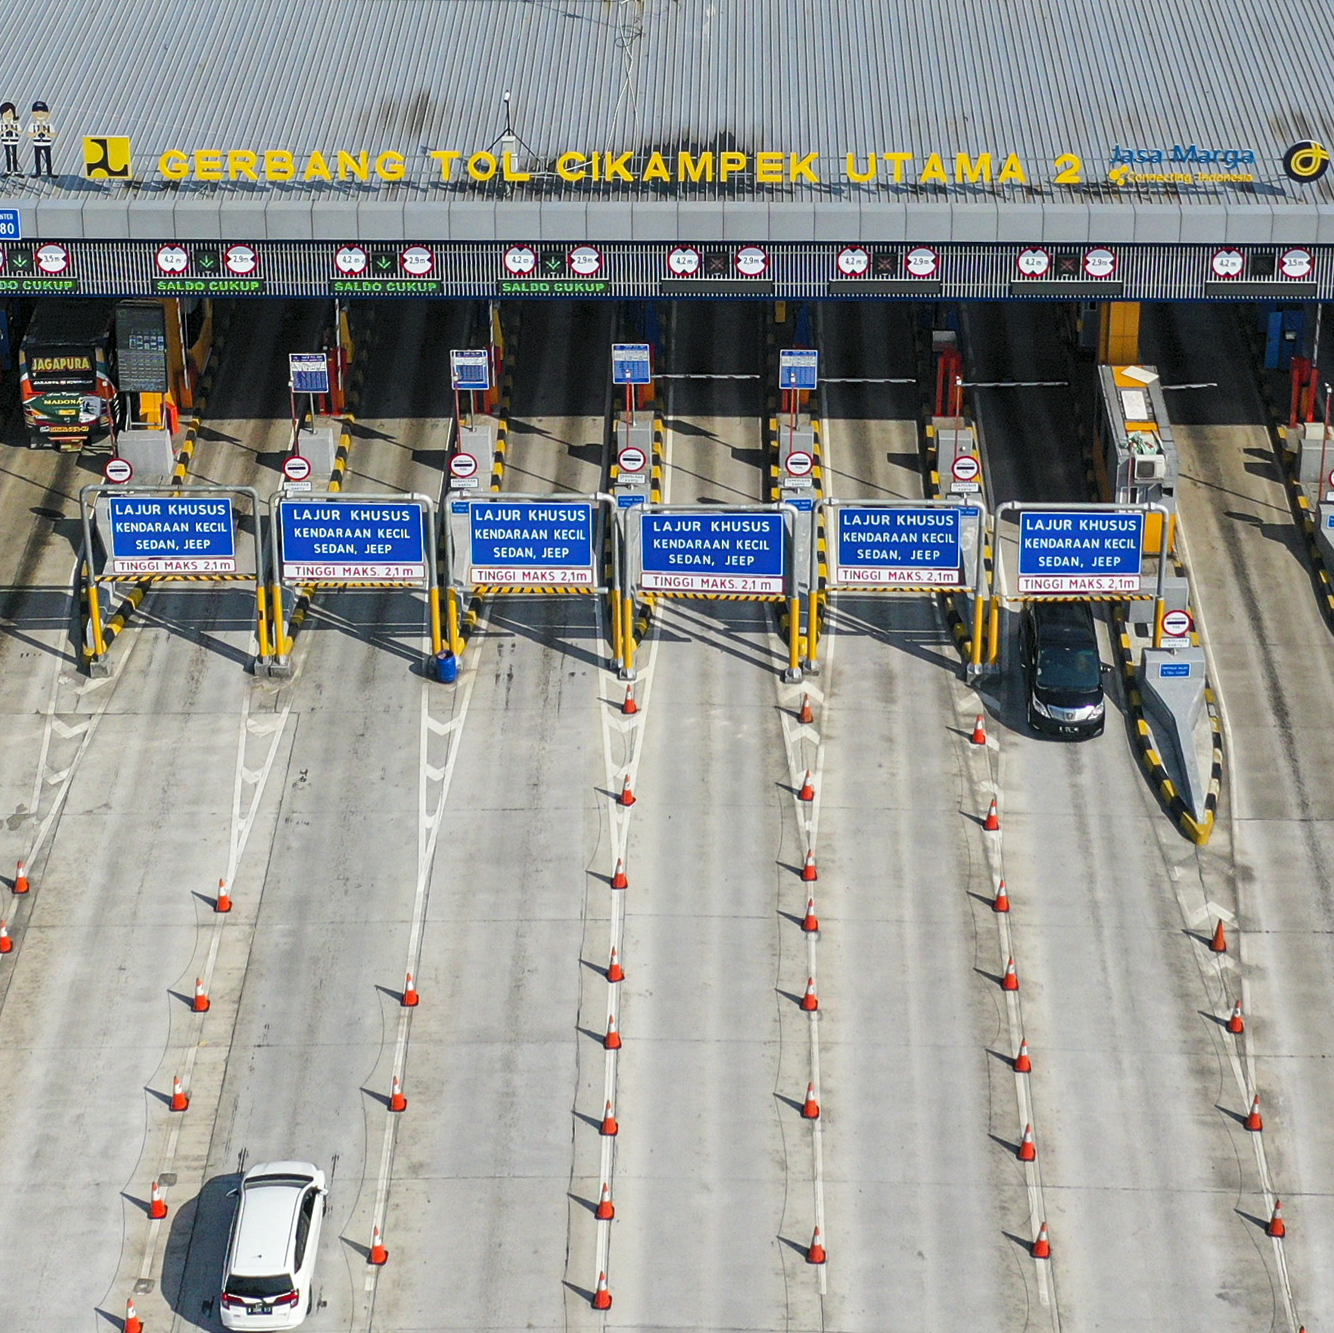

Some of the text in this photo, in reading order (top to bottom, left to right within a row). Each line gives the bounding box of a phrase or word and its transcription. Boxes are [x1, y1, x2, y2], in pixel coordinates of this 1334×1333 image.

[1109, 143, 1256, 169] Jasa Marga
[158, 149, 1081, 184] GERBANG TOL CIKAMPEK UTAMA 2
[1127, 171, 1255, 185] Connecting Indonesia
[22, 280, 73, 291] CUKUP
[156, 281, 259, 292] SALDO CUKUP
[334, 281, 437, 292] SALDO CUKUP
[502, 282, 605, 292] SALDO CUKUP
[32, 357, 90, 371] JAGAPURA
[115, 504, 226, 515] LAJUR KHUSUS
[293, 509, 410, 521] LAJUR KHUSUS
[475, 509, 585, 521] LAJUR KHUSUS
[844, 515, 954, 526] LAJUR KHUSUS
[1026, 519, 1136, 530] LAJUR KHUSUS
[116, 522, 227, 532] KENDARAAN KECIL
[653, 521, 770, 532] LAJUR KHUSUS
[294, 528, 410, 539] KENDARAAN KECIL
[475, 529, 585, 540] KENDARAAN KECIL
[843, 532, 955, 544] KENDARAAN KECIL
[135, 539, 211, 550] SEDAN, JEEP
[653, 539, 770, 550] KENDARAAN KECIL
[1025, 538, 1136, 549] KENDARAAN KECIL
[313, 544, 392, 555] SEDAN, JEEP
[493, 547, 569, 559] SEDAN, JEEP
[857, 549, 940, 560] SEDAN, JEEP
[669, 554, 755, 566] SEDAN, JEEP
[1038, 556, 1121, 568] SEDAN, JEEP
[119, 562, 159, 571] TINGGI
[295, 566, 336, 576] TINGGI
[343, 567, 380, 576] MAKS.
[478, 571, 516, 580] TINGGI
[843, 570, 881, 580] TINGGI
[888, 571, 924, 581] MAKS.
[653, 576, 693, 587] TINGGI
[701, 578, 737, 589] MAKS.
[1024, 579, 1063, 589] TINGGI
[1069, 579, 1105, 589] MAKS.
